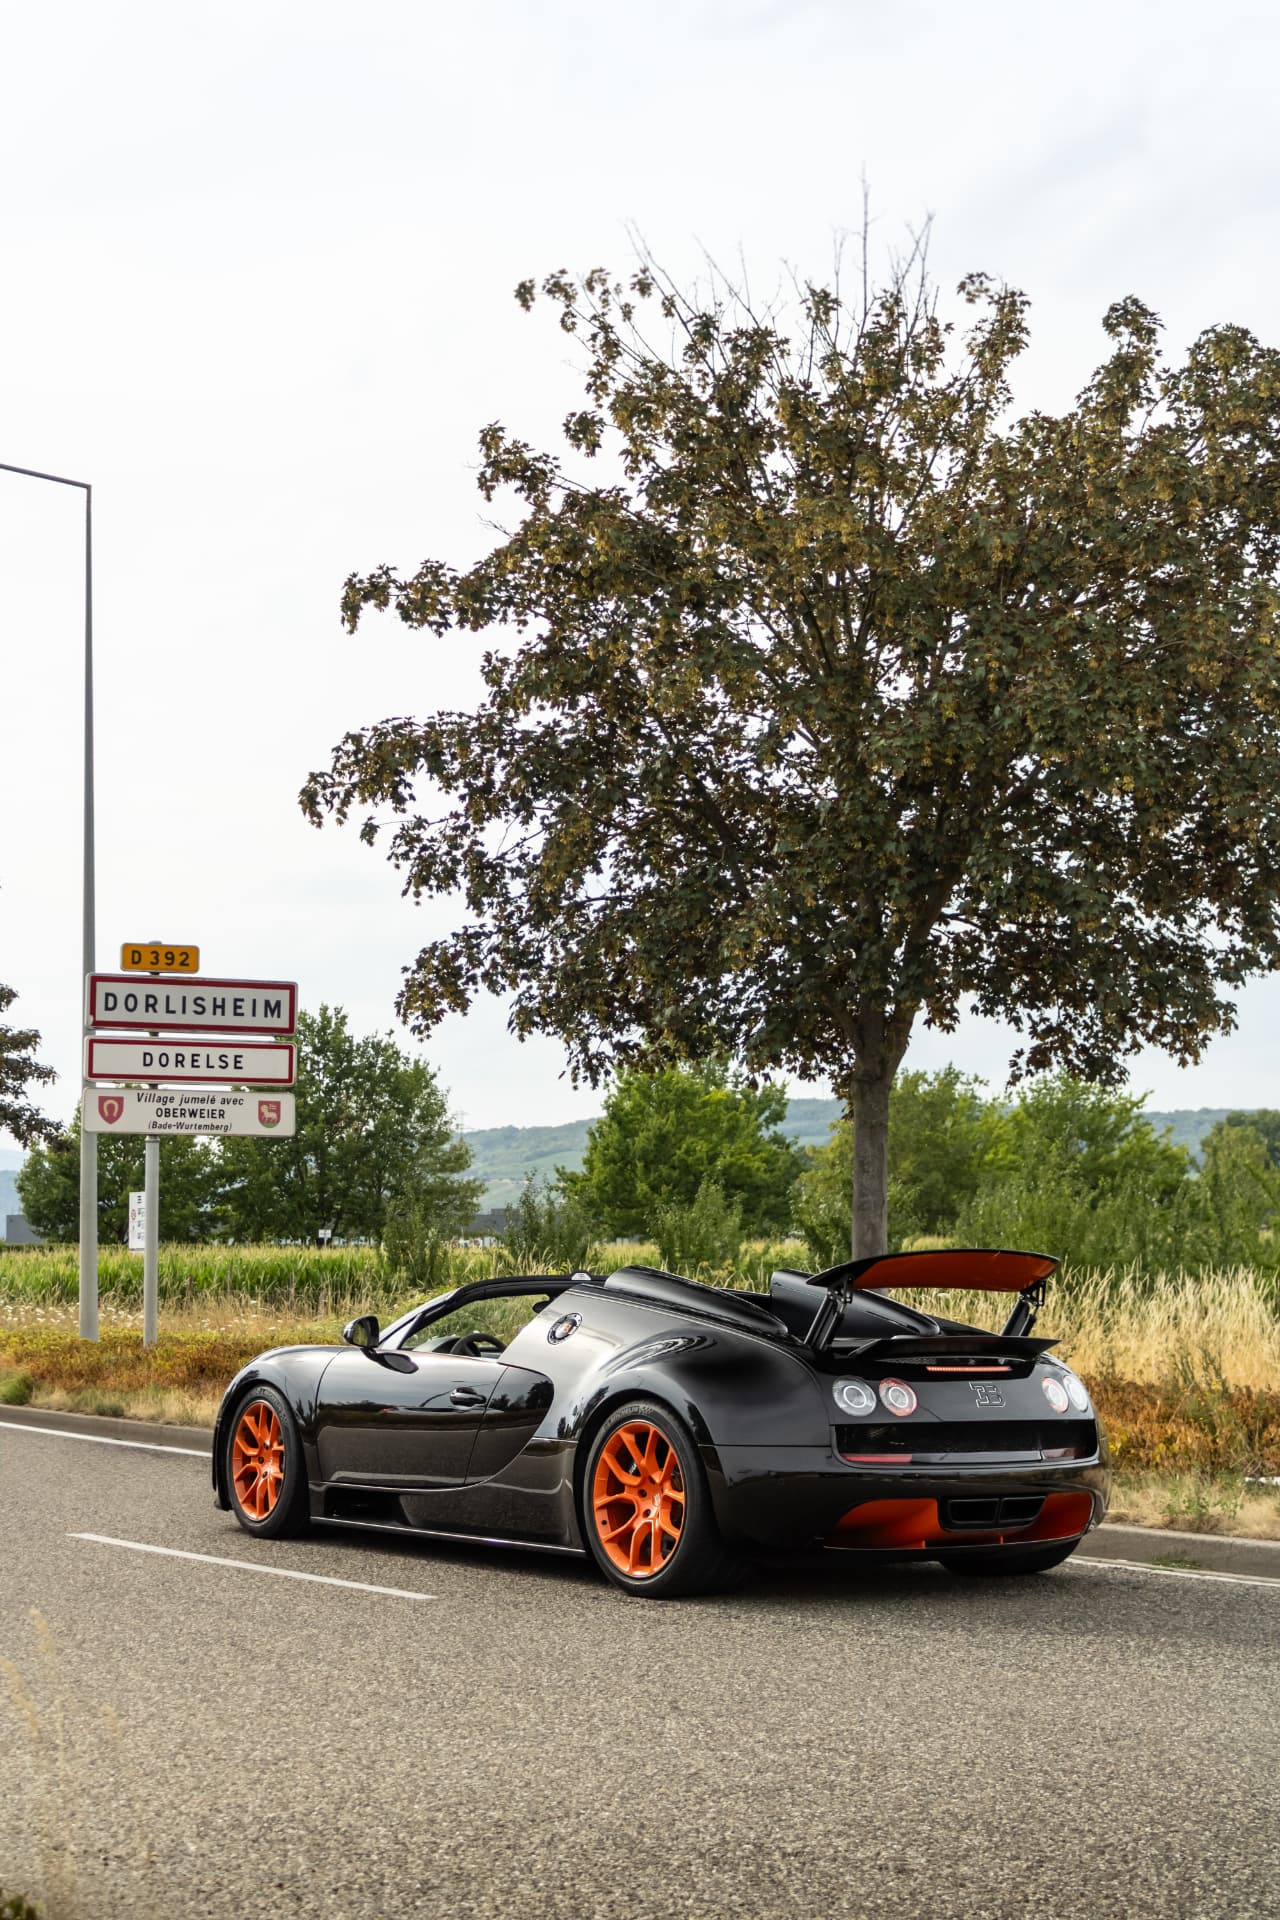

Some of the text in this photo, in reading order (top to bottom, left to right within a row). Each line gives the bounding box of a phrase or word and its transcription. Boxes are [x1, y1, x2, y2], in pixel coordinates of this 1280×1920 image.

[131, 950, 190, 967] D 392
[104, 992, 282, 1018] DORLISHEIM
[142, 1052, 243, 1069] DORELSE
[137, 1092, 175, 1106] Village
[179, 1094, 216, 1106] jumelé
[155, 1107, 225, 1119] OBERWEIER
[148, 1121, 232, 1132] (Bade-Wurtemberg)
